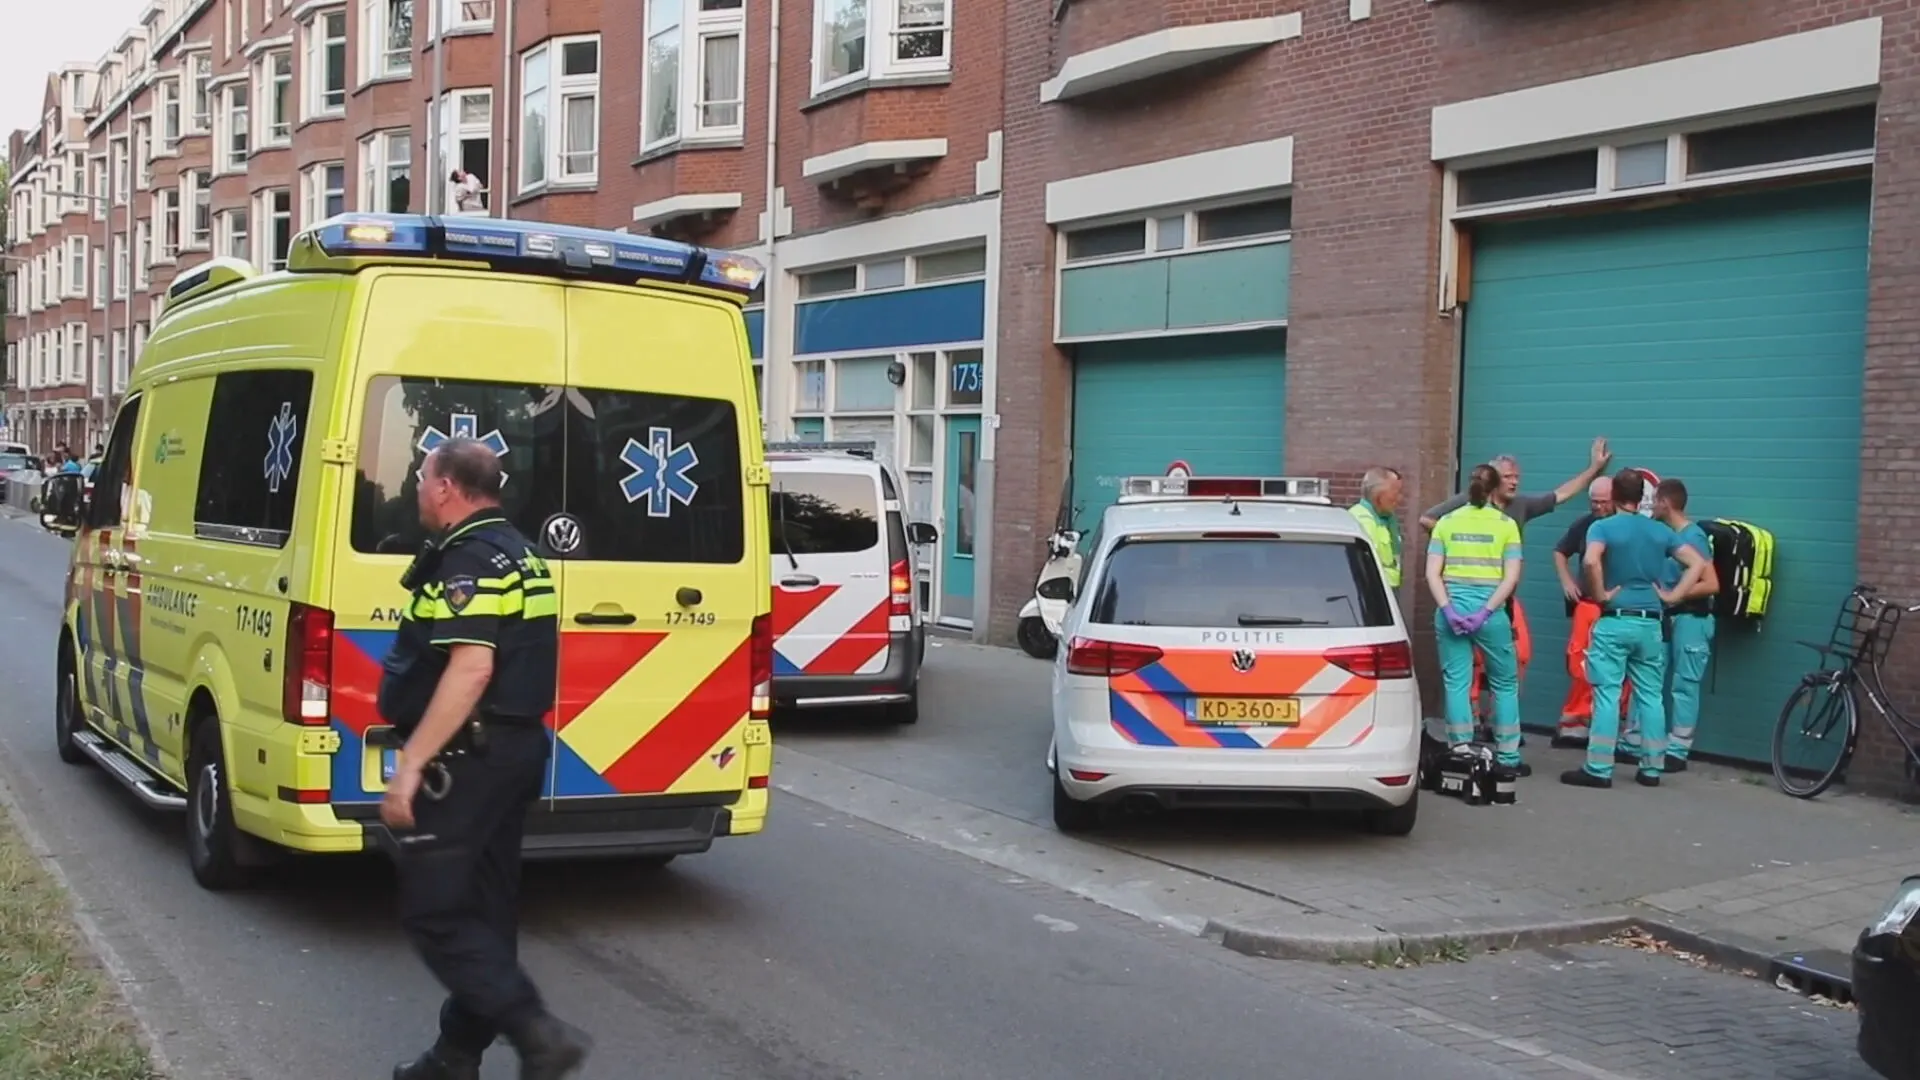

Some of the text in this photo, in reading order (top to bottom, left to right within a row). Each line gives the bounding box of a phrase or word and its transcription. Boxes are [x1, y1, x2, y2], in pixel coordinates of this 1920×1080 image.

[952, 363, 978, 391] 173
[147, 584, 198, 618] AMBULANCE
[236, 604, 272, 638] 17-149
[664, 611, 716, 626] 17-149
[1202, 631, 1285, 644] POLITIE
[1202, 701, 1291, 719] KD-360-J
